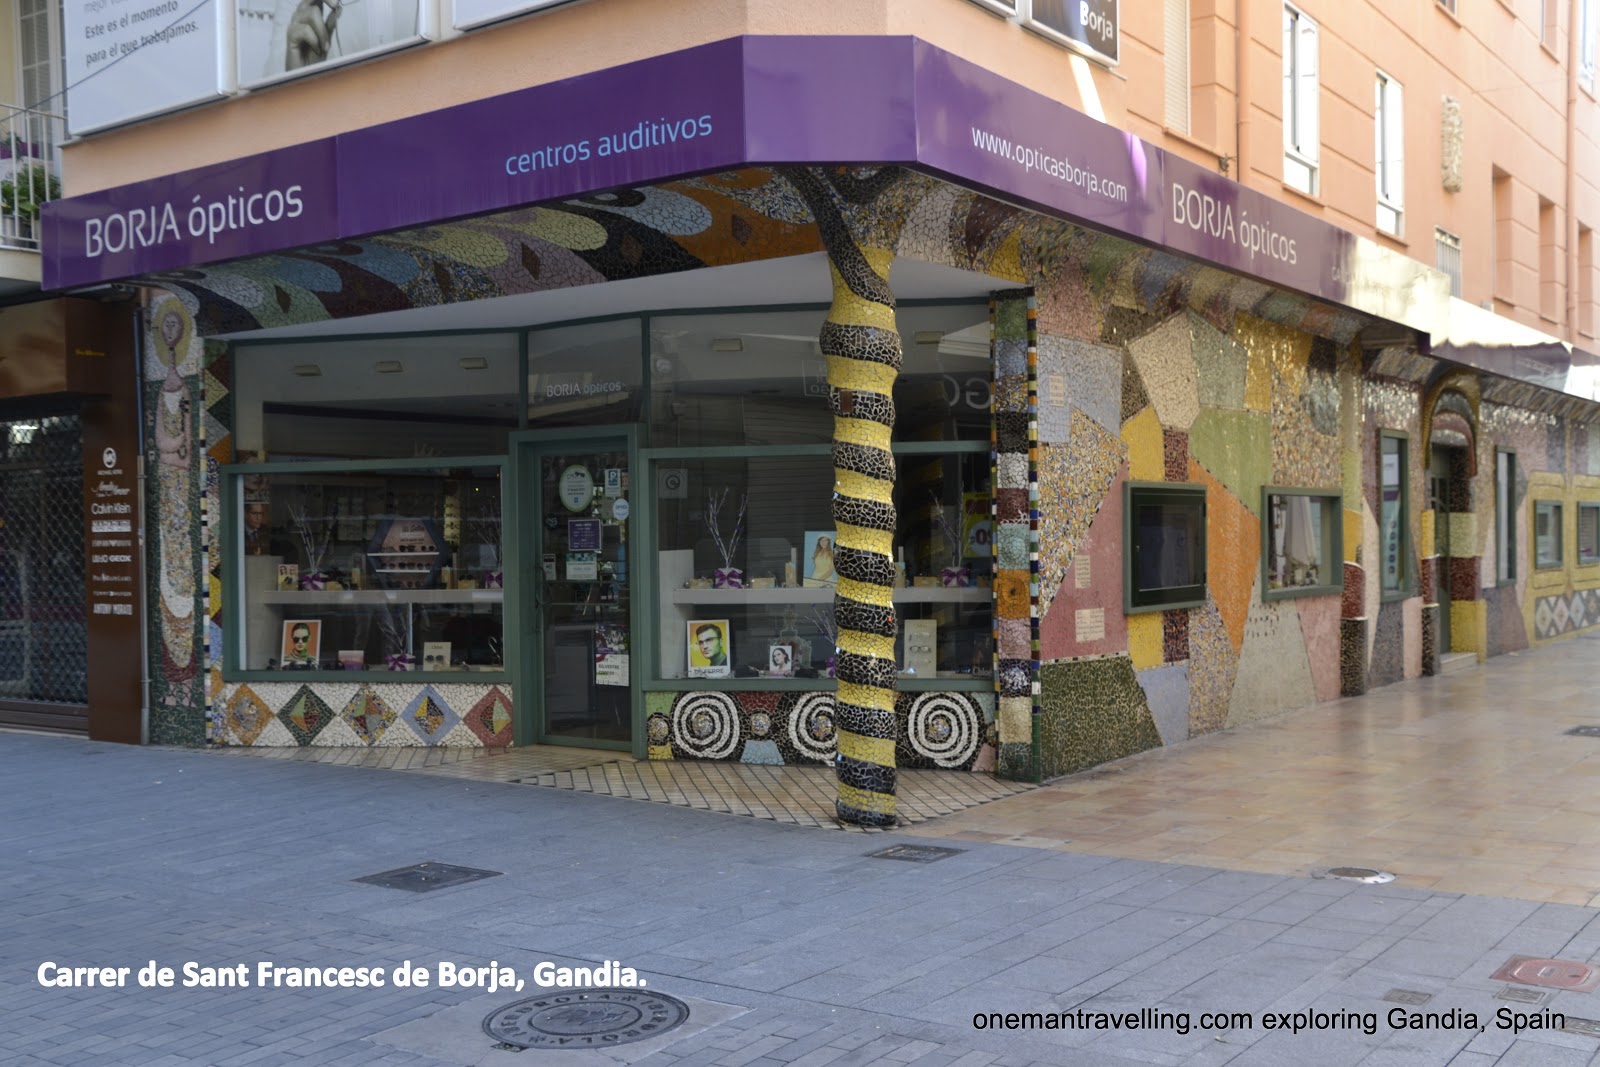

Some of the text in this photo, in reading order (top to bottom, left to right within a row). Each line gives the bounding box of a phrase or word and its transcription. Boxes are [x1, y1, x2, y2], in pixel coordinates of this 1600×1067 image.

[85, 0, 178, 39] Este es el momento
[1080, 1, 1113, 41] Borja
[86, 20, 199, 68] para el que trabajamos.
[505, 114, 712, 176] centros auditivos
[971, 126, 1128, 203] www.opticasborja.com
[85, 184, 303, 258] BORJA ópticos
[1172, 182, 1298, 265] BORJA ópticos
[546, 383, 581, 398] BORJA
[109, 554, 132, 562] GEOX
